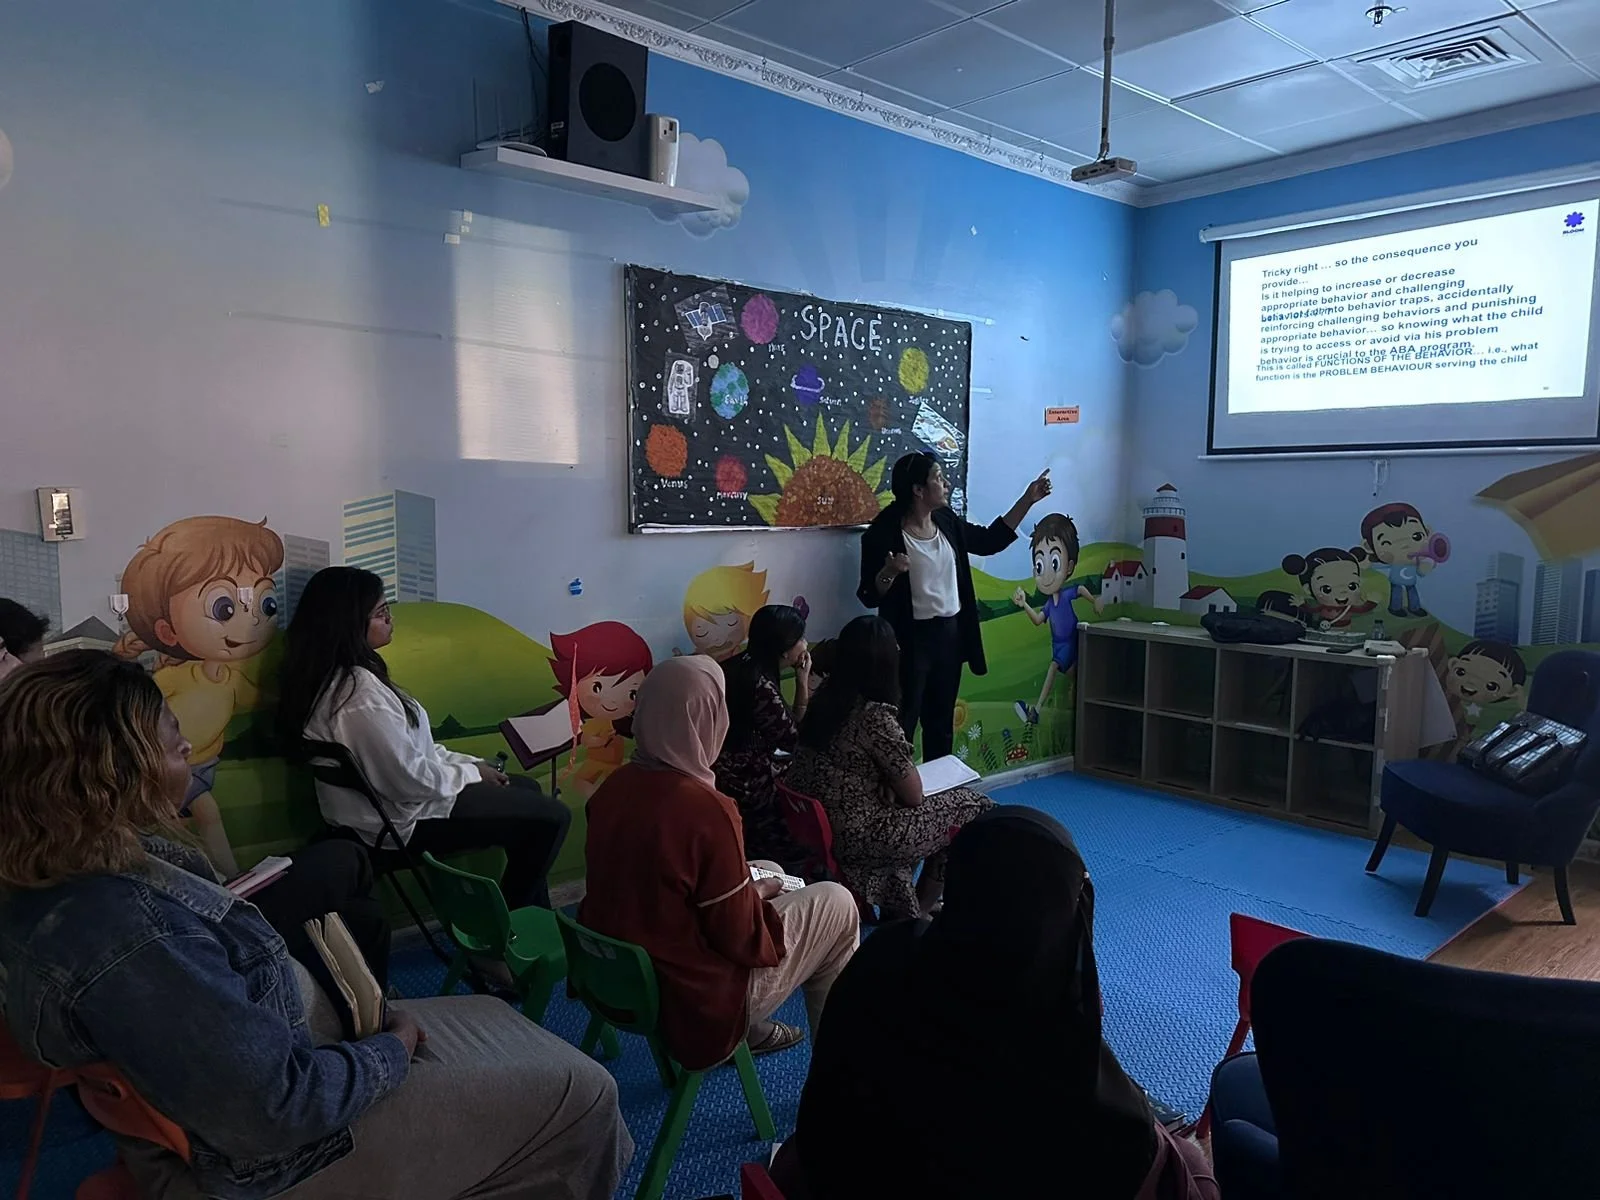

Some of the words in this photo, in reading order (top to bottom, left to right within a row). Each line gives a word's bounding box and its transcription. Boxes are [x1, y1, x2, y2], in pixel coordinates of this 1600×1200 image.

[1262, 267, 1291, 278] Tricky
[1294, 263, 1318, 274] right
[1335, 258, 1348, 267] so
[1351, 255, 1368, 264] the
[1372, 242, 1451, 262] consequence
[1454, 238, 1478, 250] you
[1261, 299, 1318, 312] appropriate
[1322, 291, 1368, 304] behavior
[1371, 287, 1392, 298] and
[1396, 279, 1465, 295] challenging
[1282, 287, 1318, 298] helping
[1336, 278, 1382, 290] increase
[1386, 276, 1398, 284] or
[1400, 268, 1456, 282] decrease
[1348, 296, 1396, 311] behavior
[1438, 284, 1514, 300] accidentally
[800, 304, 882, 351] SPACE
[1260, 332, 1317, 344] appropriate
[1398, 318, 1448, 330] knowing
[1452, 315, 1482, 324] what
[1487, 311, 1507, 320] the
[1510, 306, 1544, 318] child
[1261, 321, 1314, 333] reinforcing
[1318, 313, 1380, 327] challenging
[1383, 306, 1440, 320] behaviors
[1444, 302, 1468, 312] and
[1472, 295, 1537, 312] punishing
[1260, 356, 1302, 365] behavior
[1317, 350, 1352, 360] crucial
[1355, 350, 1366, 358] to
[1370, 348, 1386, 356] the
[1390, 345, 1416, 354] ABA
[1420, 341, 1475, 354] program.
[1271, 344, 1300, 355] trying
[1302, 344, 1312, 352] to
[1316, 340, 1351, 350] access
[1355, 338, 1366, 346] or
[1370, 334, 1400, 345] avoid
[1404, 332, 1420, 341] via
[1424, 330, 1442, 339] his
[1446, 325, 1498, 339] problem
[1256, 373, 1290, 382] function
[1320, 367, 1368, 377] PROBLEM
[1370, 362, 1432, 374] BEHAVIOUR
[1436, 360, 1476, 369] serving
[1480, 358, 1497, 366] the
[1500, 354, 1528, 364] child
[1286, 362, 1312, 370] called
[1314, 356, 1370, 368] FUNCTIONS
[1374, 354, 1387, 362] OF
[1391, 352, 1411, 361] THE
[1510, 342, 1538, 352] what
[660, 478, 688, 489] Venus
